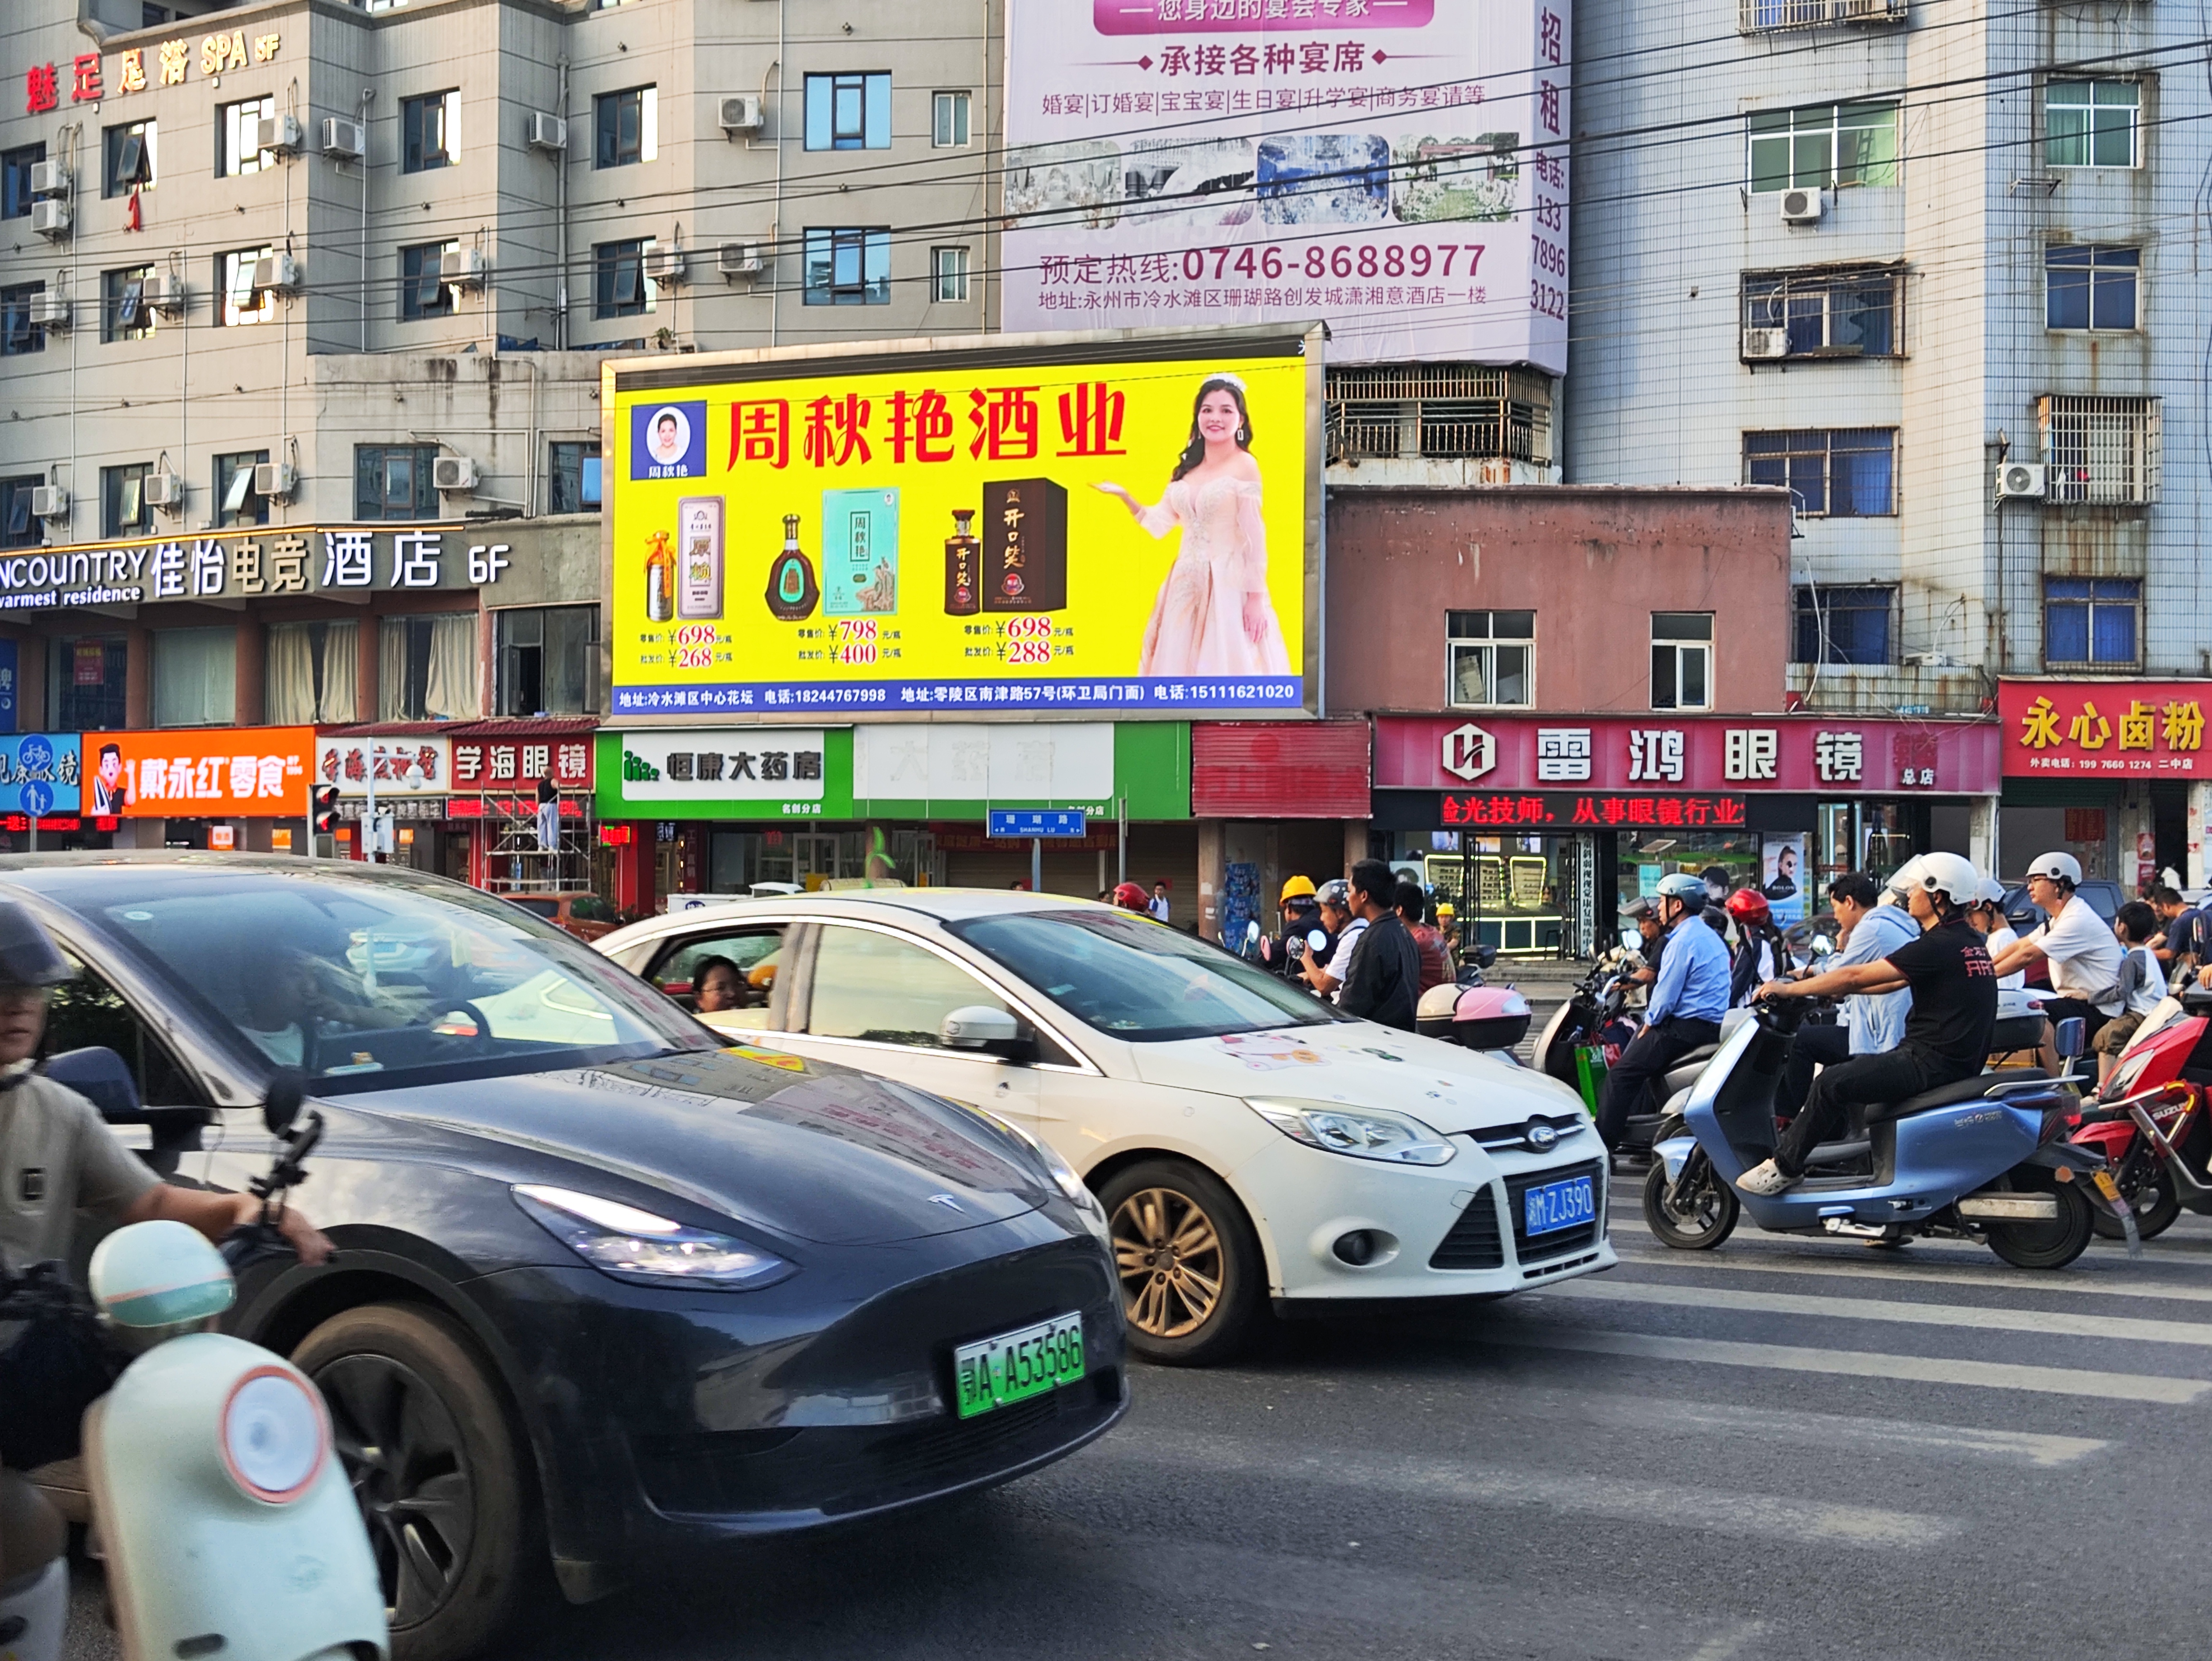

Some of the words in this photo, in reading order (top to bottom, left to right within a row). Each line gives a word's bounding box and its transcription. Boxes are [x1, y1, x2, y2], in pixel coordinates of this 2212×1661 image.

[1158, 0, 1370, 21] 您身边的宴会专家
[200, 30, 247, 75] SPA
[1160, 41, 1365, 76] 承接各种宴席
[1540, 6, 1561, 135] 招租
[1536, 150, 1564, 189] 电话:
[1537, 194, 1561, 232] 133
[1532, 234, 1565, 278] 7896
[1530, 279, 1564, 321] 3122
[727, 382, 1127, 472] 周秋艳酒业
[648, 465, 688, 479] 周秋艳
[1003, 508, 1025, 569] 开口笑
[151, 530, 441, 598] 佳怡电竞酒店
[468, 544, 509, 585] 6F
[956, 548, 971, 587] 开口笑
[0, 589, 57, 609] armest
[63, 585, 141, 606] residence
[765, 688, 886, 705] 电话:18244767998
[1154, 684, 1294, 700] 电话:15111621020
[2019, 696, 2205, 751] 永心卤粉
[456, 743, 586, 780] 学海眼镜
[667, 751, 821, 781] 恒康大药房
[1537, 728, 1863, 782] 雷鸿眼镜
[2079, 760, 2097, 769] 199
[2101, 760, 2124, 769] 7660
[2129, 760, 2152, 769] 1274
[2158, 758, 2193, 770] 二中店
[139, 754, 287, 799] 戴永红零食
[1902, 768, 1934, 785] 总店
[1006, 814, 1068, 824] 珊瑚路
